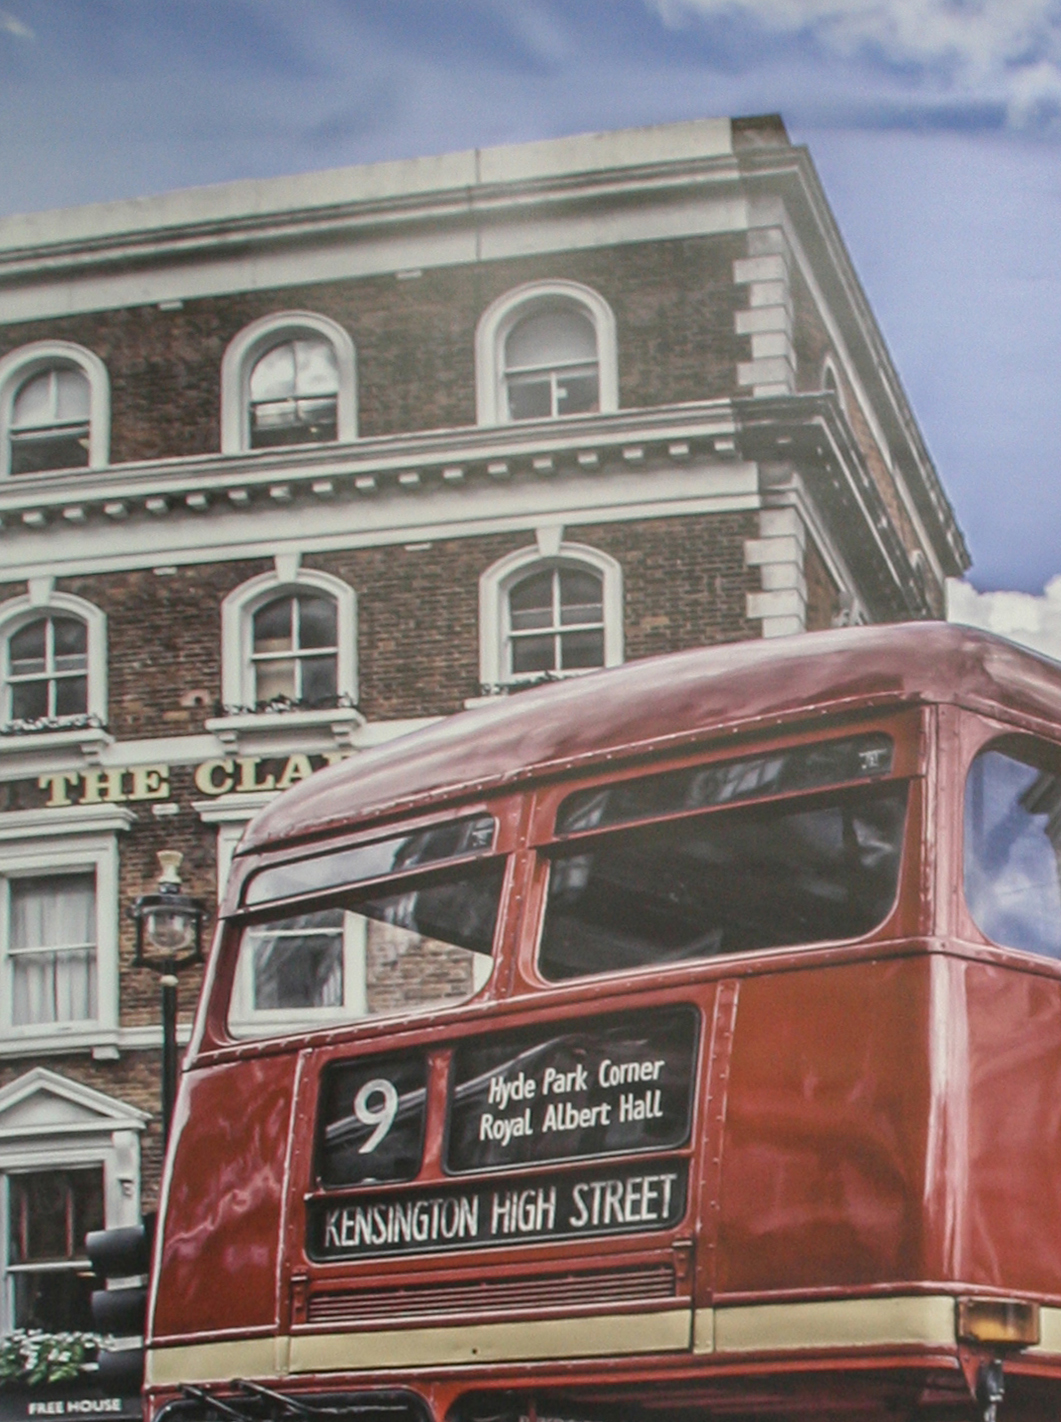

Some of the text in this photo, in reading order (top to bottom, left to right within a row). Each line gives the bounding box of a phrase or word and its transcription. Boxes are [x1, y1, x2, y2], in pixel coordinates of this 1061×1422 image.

[38, 751, 356, 807] THE CLA
[488, 1058, 666, 1110] Hyde Park Corner
[353, 1078, 399, 1154] 9
[479, 1090, 663, 1146] Royal Albert Hall
[324, 1174, 678, 1248] KENSINGTON HIGH STREET
[28, 1398, 121, 1415] FREE HOUSE
